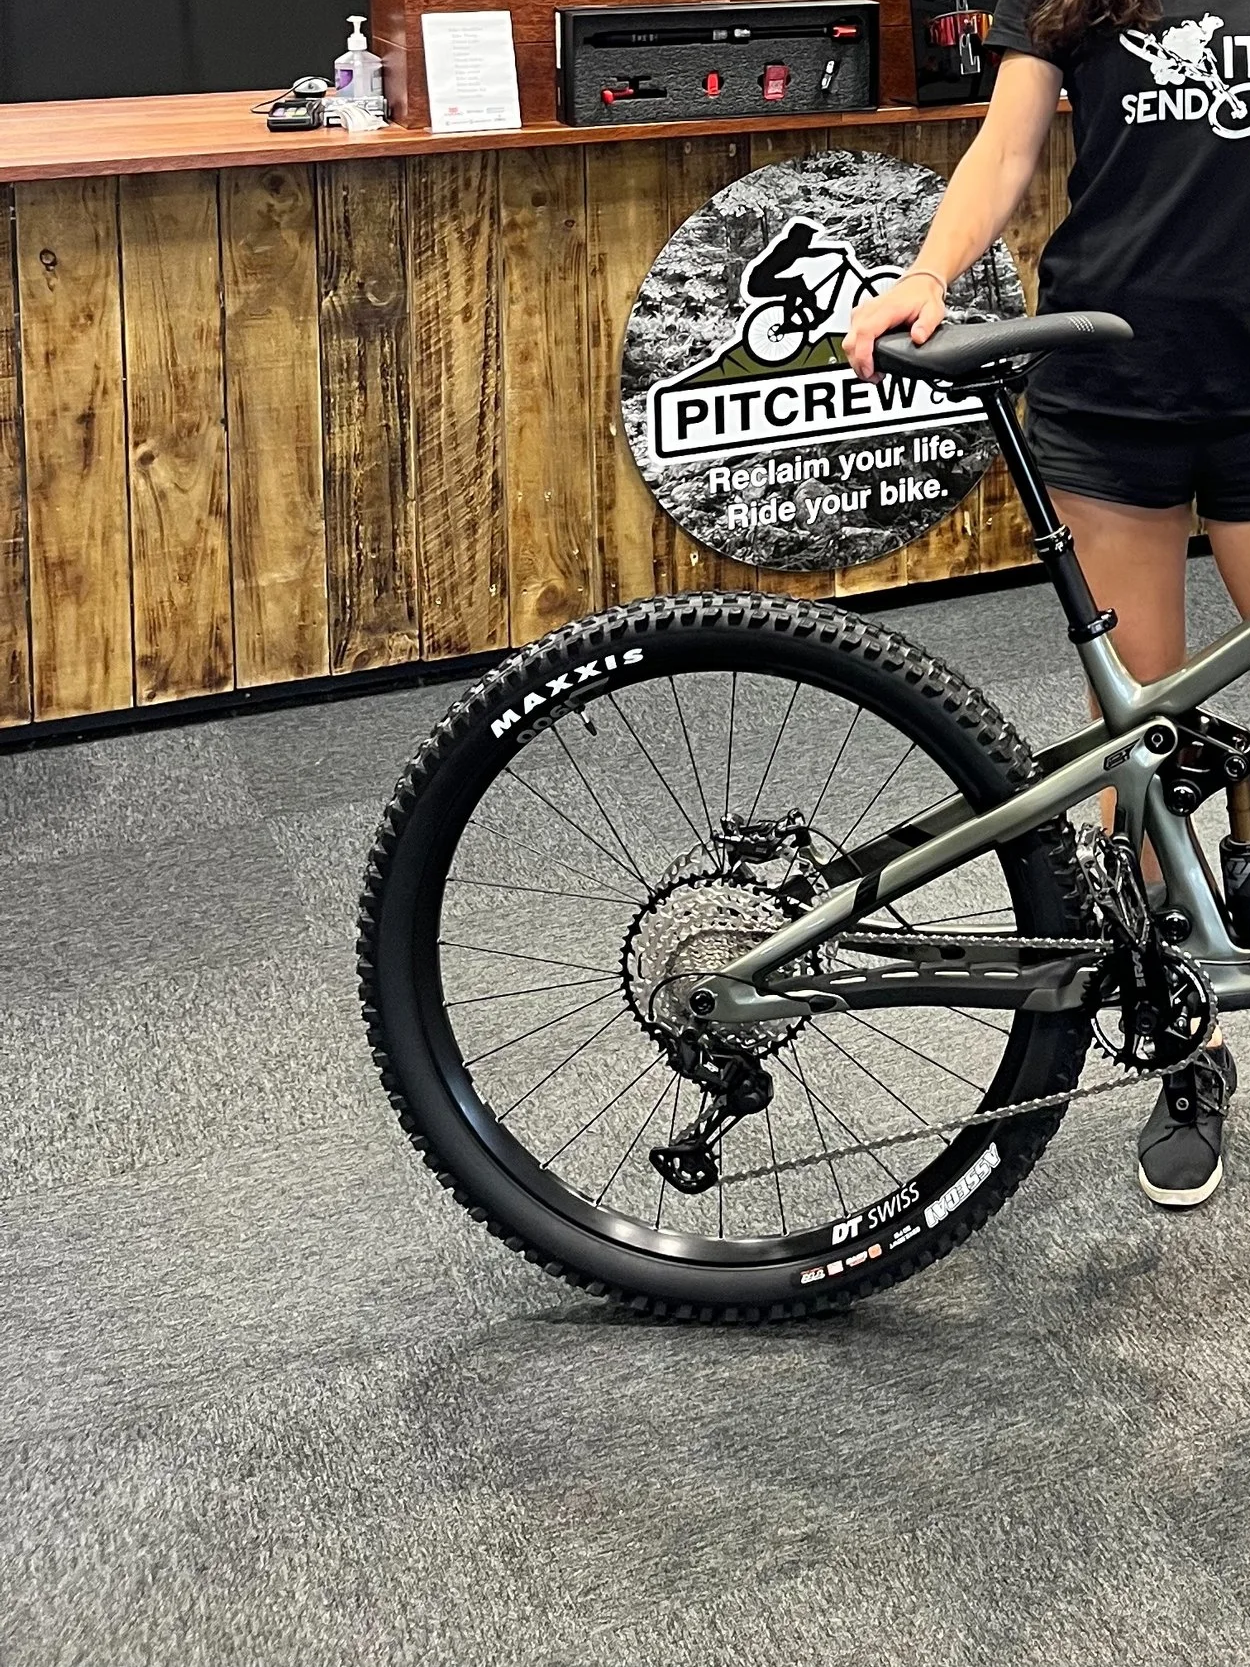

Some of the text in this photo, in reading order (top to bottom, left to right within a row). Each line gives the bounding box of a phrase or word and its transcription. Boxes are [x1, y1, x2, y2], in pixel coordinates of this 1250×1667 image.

[1121, 88, 1209, 125] SEND
[676, 378, 918, 440] PITCREW
[709, 434, 964, 494] Reclaim your life.
[727, 476, 949, 531] Ride your bike.
[490, 648, 644, 739] MAXXIS
[831, 1215, 863, 1246] DT
[867, 1181, 920, 1230] SWISS
[923, 1141, 1001, 1229] ASSEGAI
